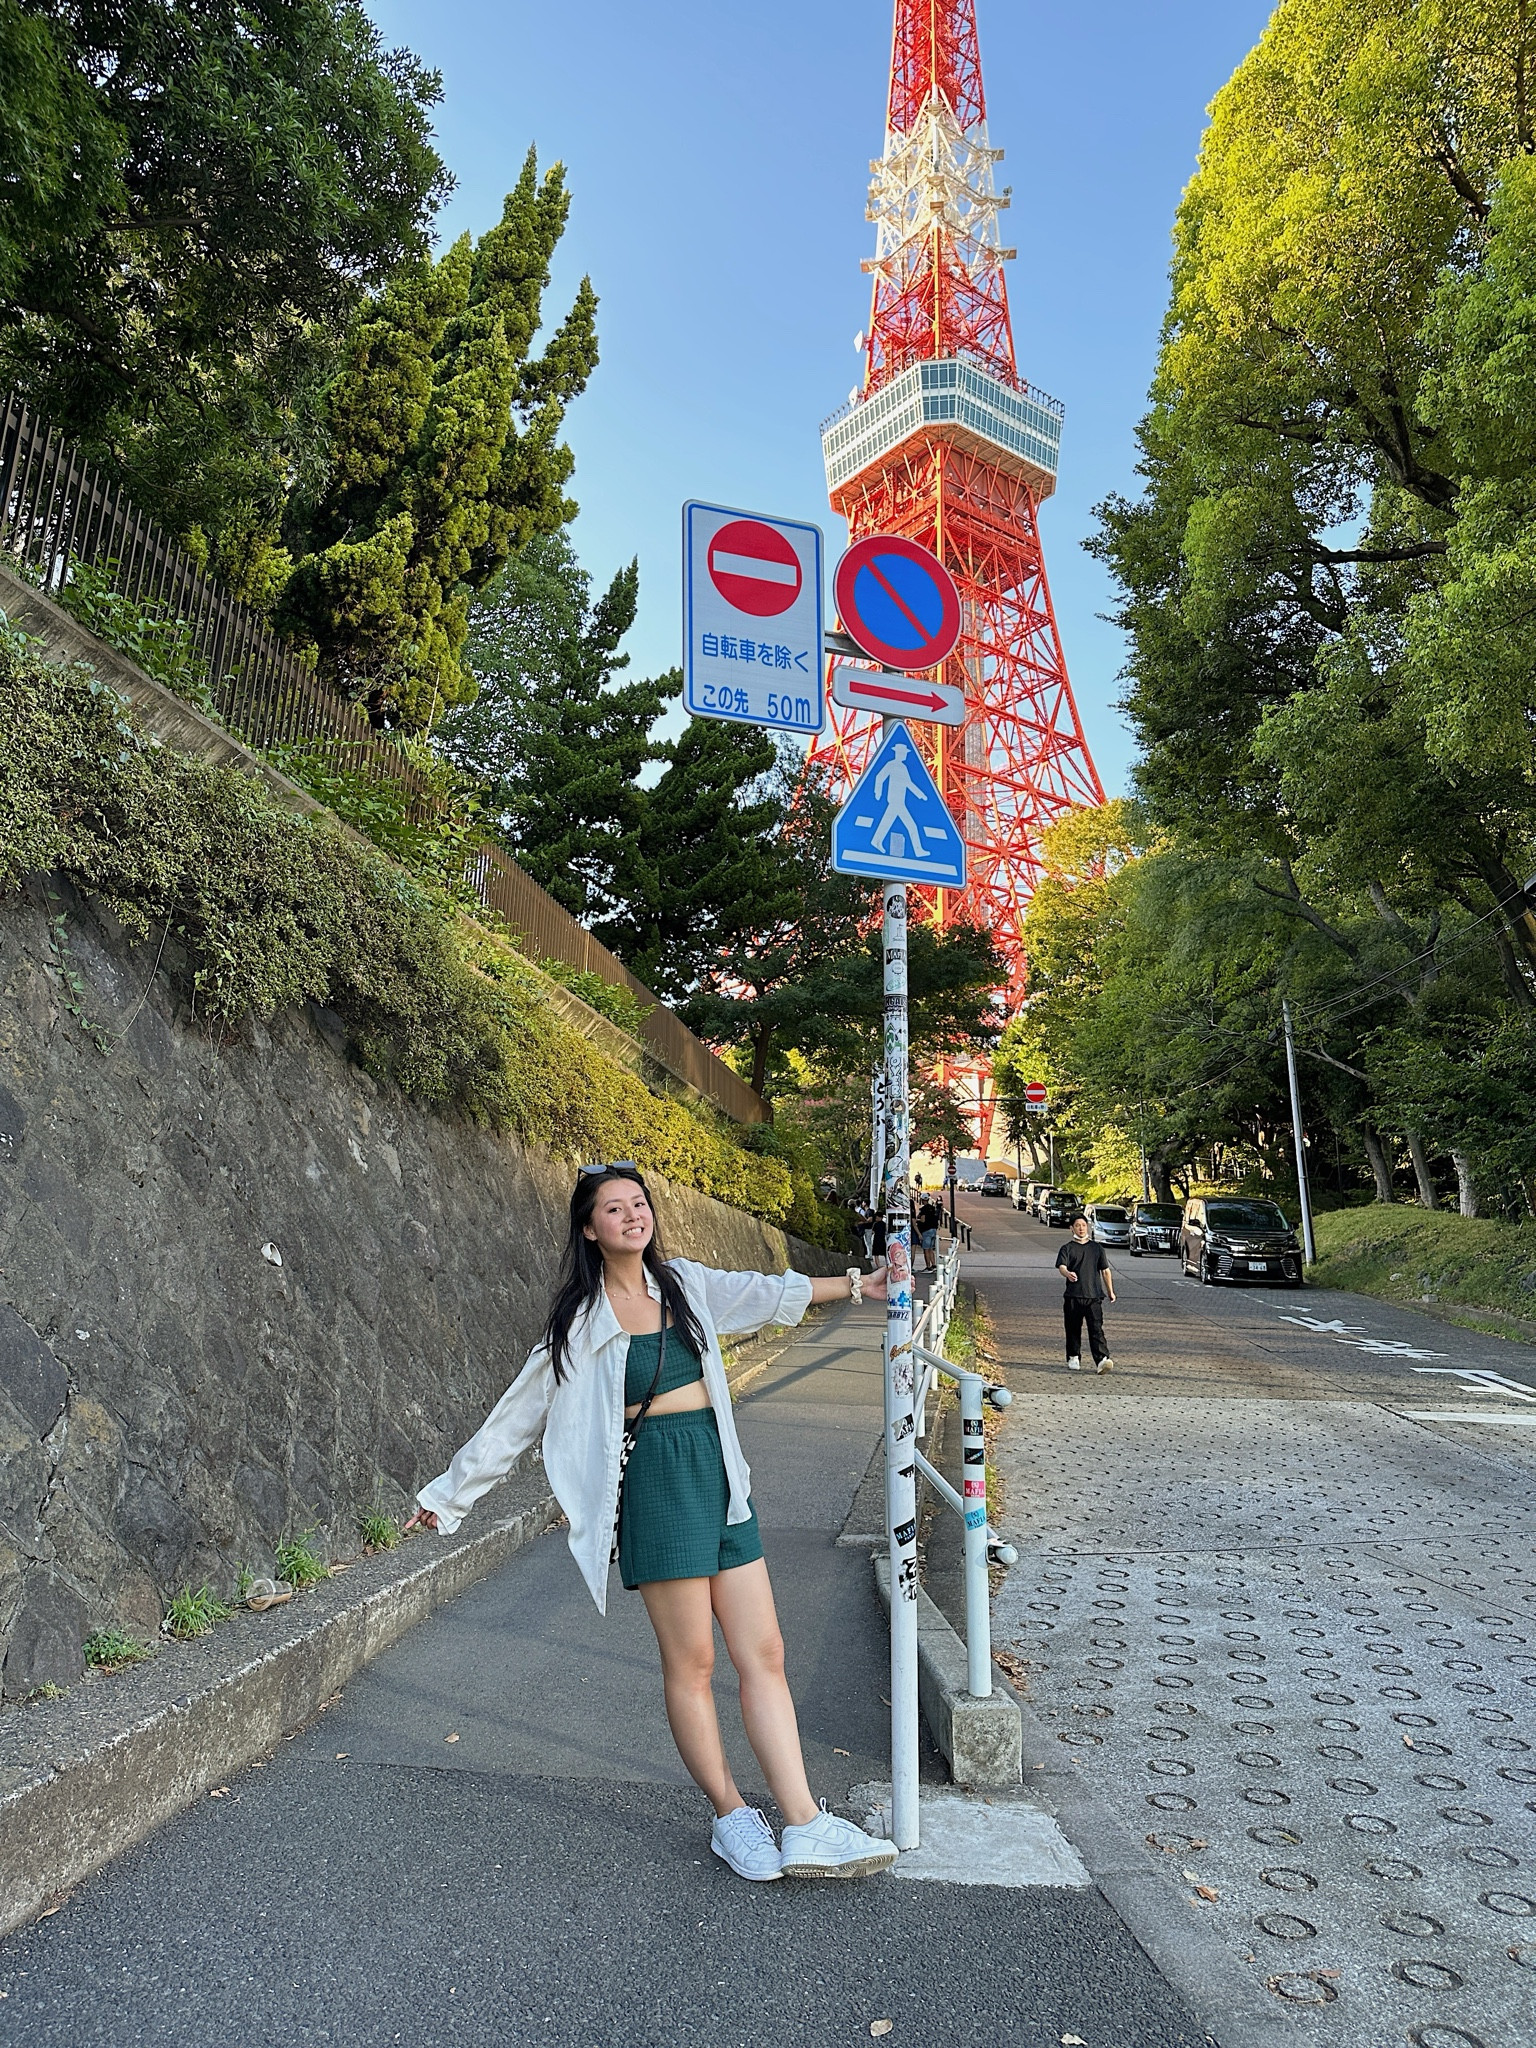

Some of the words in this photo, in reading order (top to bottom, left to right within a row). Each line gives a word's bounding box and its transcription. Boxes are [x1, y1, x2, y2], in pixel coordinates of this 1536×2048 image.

[702, 632, 809, 673] 自転車を除く
[703, 684, 749, 714] この先
[767, 693, 811, 723] 50m
